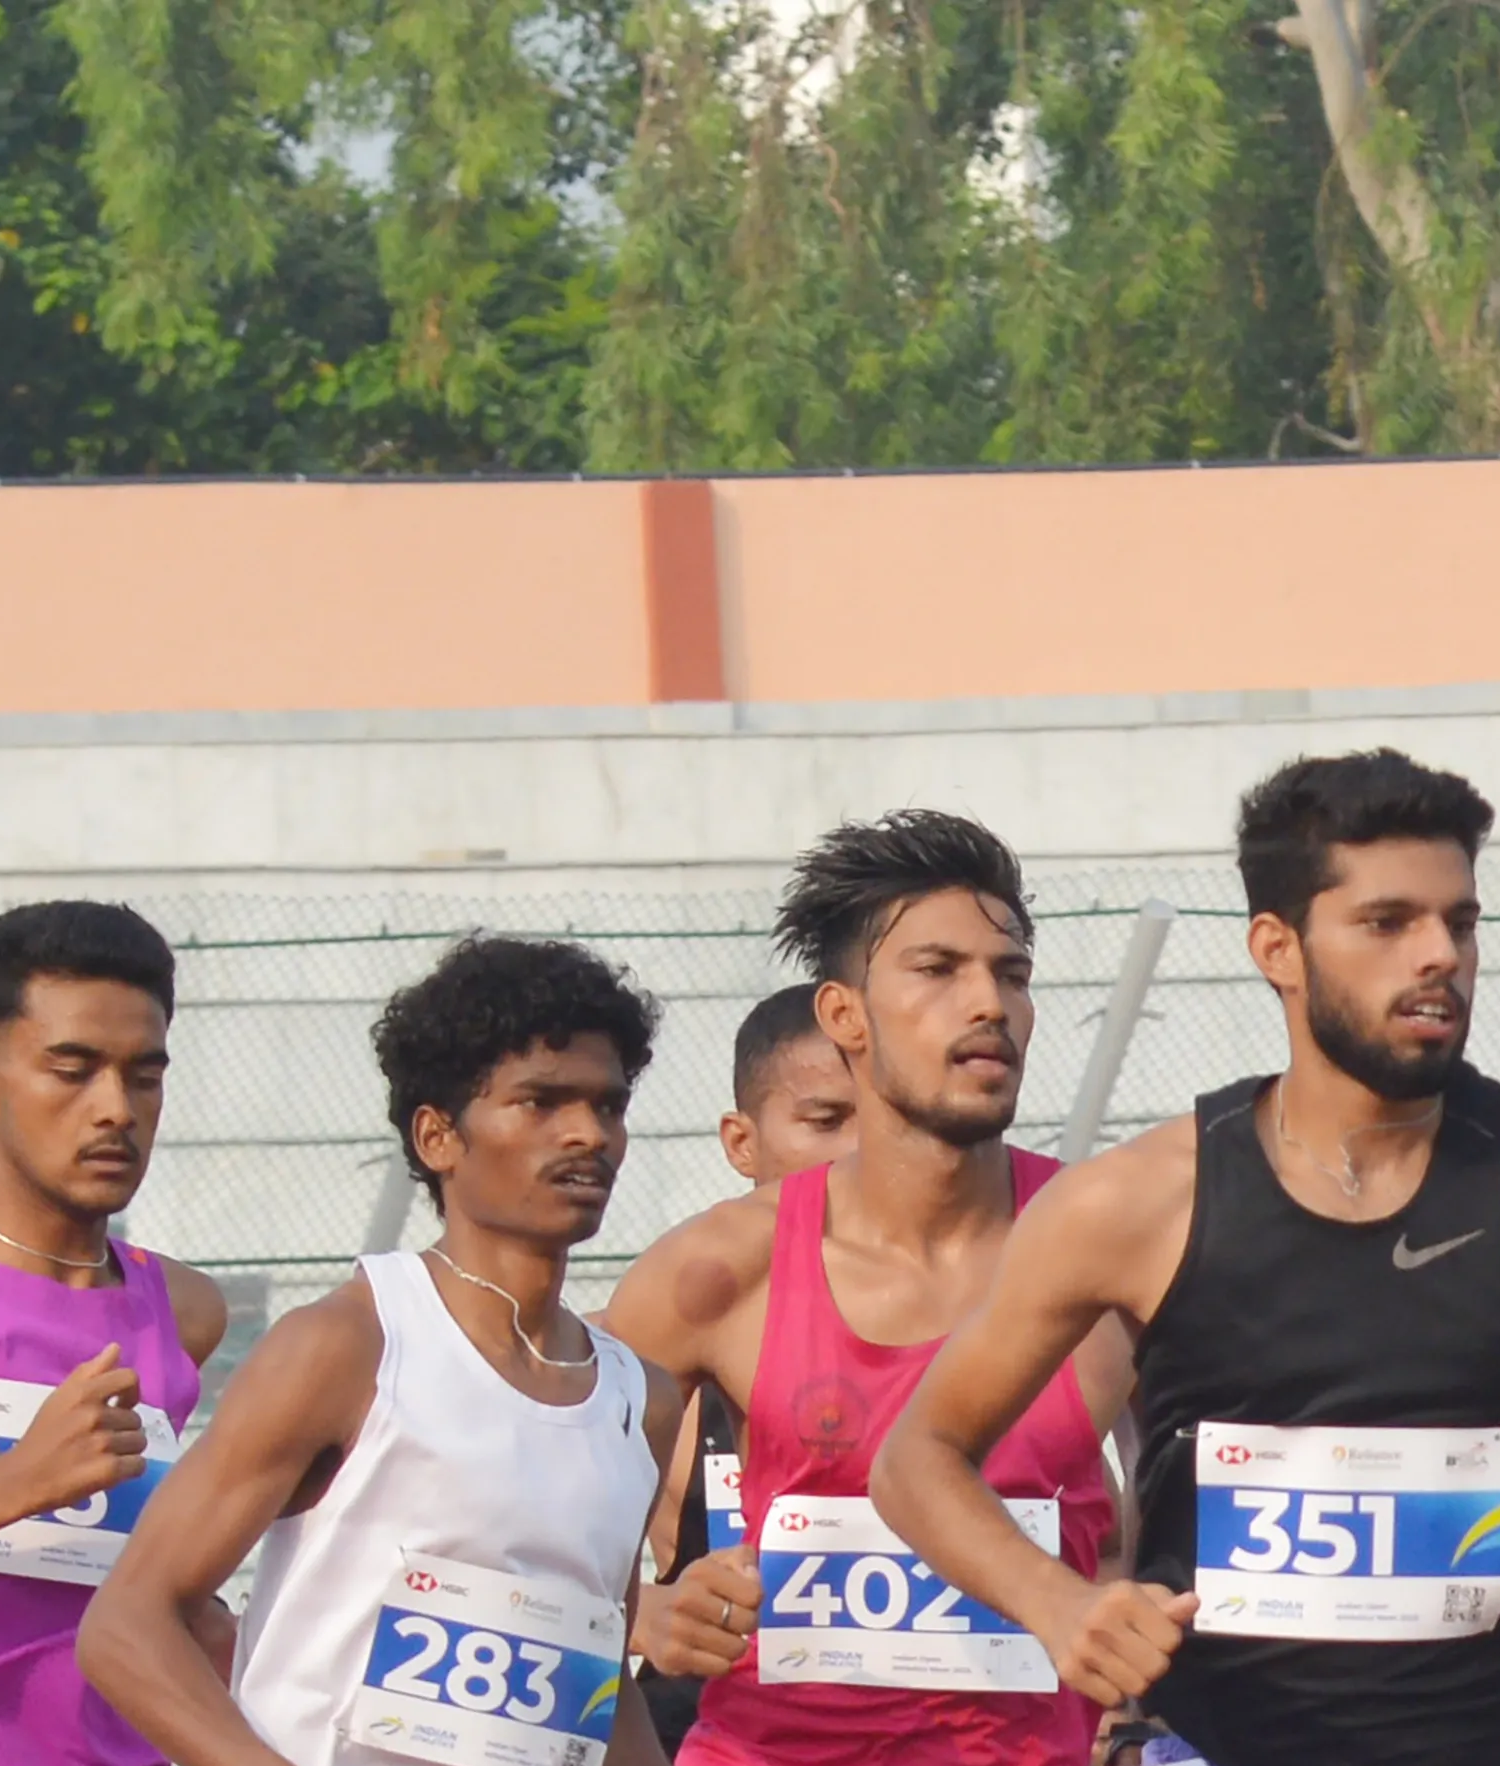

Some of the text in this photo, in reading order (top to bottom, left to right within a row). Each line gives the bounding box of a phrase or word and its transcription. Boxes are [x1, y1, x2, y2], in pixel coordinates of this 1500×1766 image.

[813, 1517, 844, 1528] HSBC
[1229, 1490, 1396, 1576] 351
[773, 1555, 971, 1632] 402
[381, 1616, 562, 1725] 283
